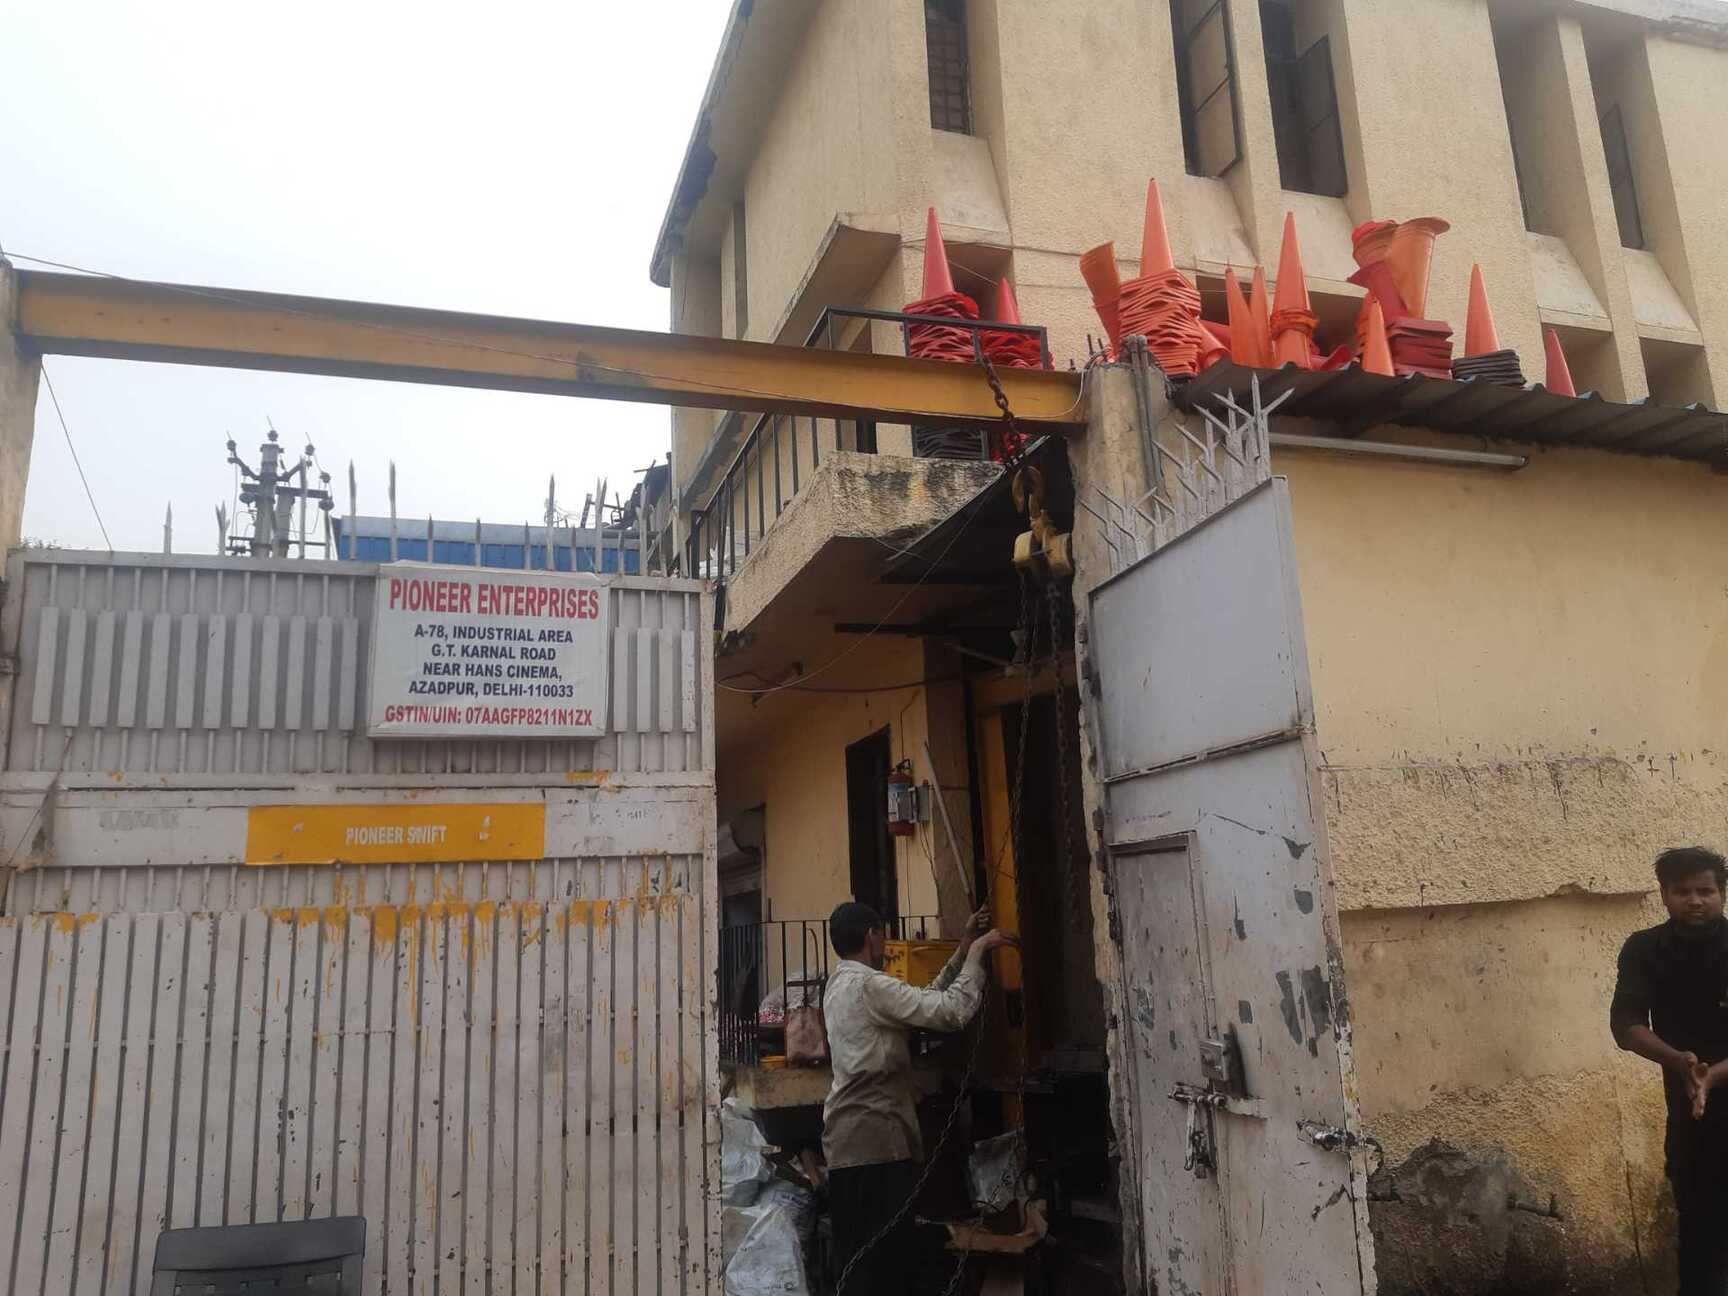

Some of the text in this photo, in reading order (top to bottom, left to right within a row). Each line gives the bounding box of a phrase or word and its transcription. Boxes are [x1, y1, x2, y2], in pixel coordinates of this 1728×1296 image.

[389, 579, 599, 619] PIONEER ENTERPRISES
[414, 624, 573, 643] A-78, INDUSTRIAL AREA
[432, 644, 556, 661] G.T. KARNAL ROAD
[423, 662, 562, 681] NEAR HANS CINEMA,
[409, 681, 574, 698] AZADPUR, DELHI-110033
[385, 705, 462, 724] GSTIN/UIN:
[345, 826, 403, 845] PIONEER
